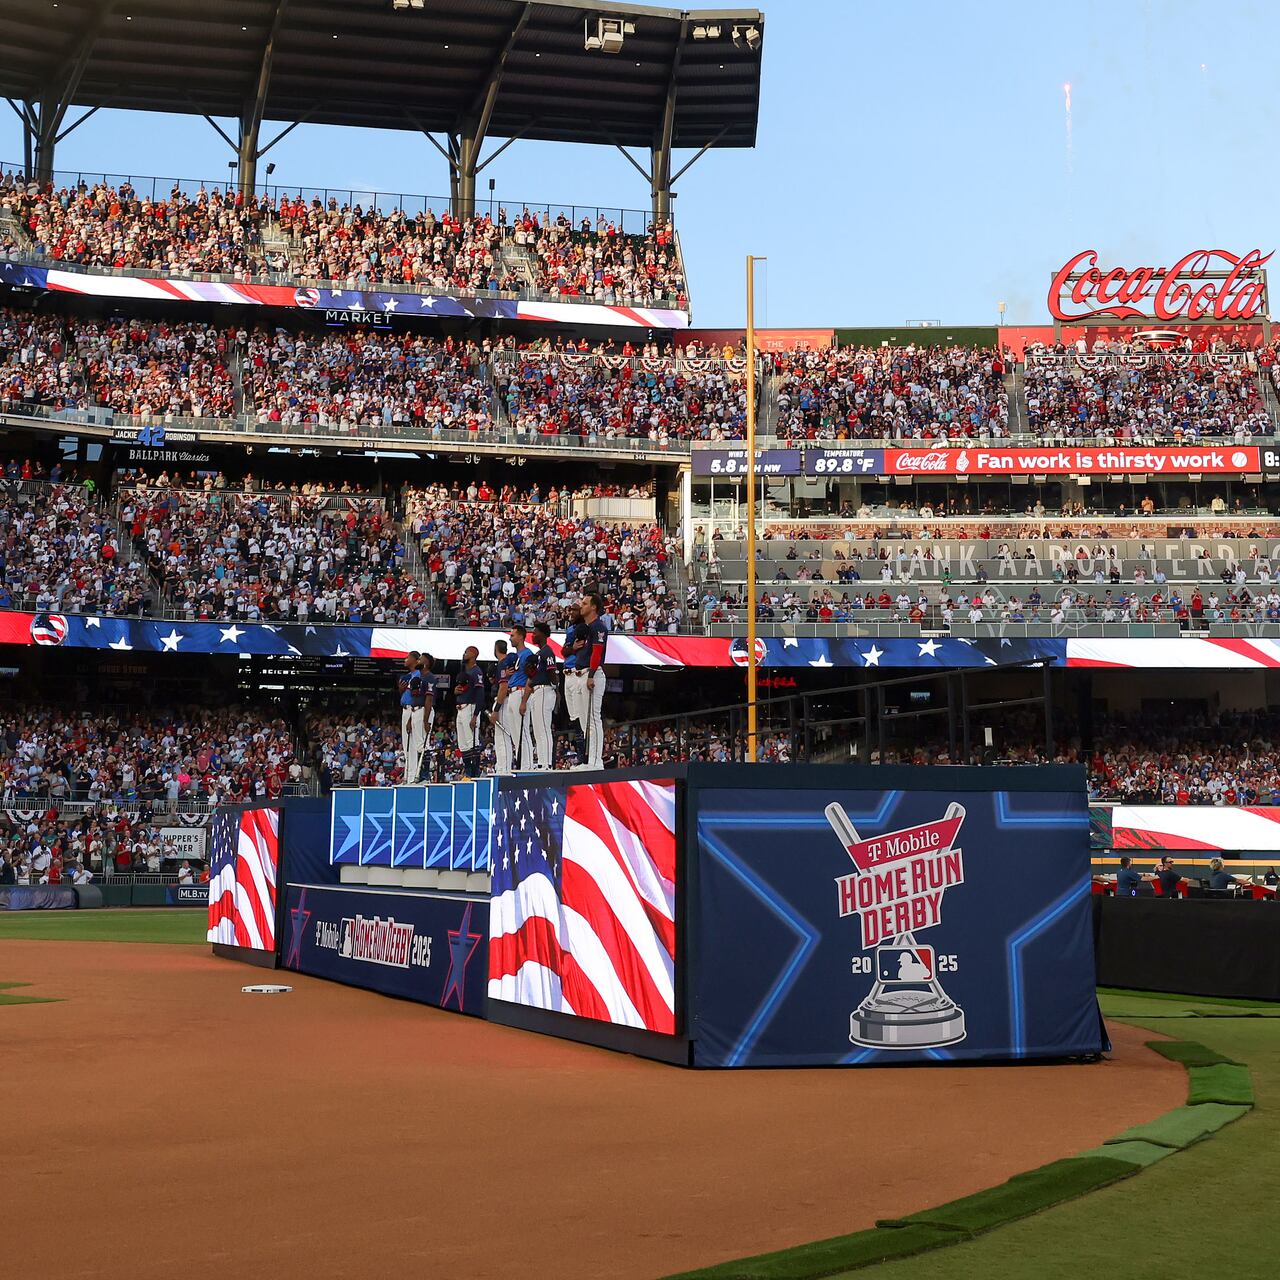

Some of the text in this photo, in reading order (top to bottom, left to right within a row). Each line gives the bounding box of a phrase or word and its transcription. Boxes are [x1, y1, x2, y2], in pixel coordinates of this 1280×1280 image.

[1048, 249, 1276, 321] Coca-Cola
[326, 310, 392, 324] MARKET
[115, 425, 196, 447] JACKIE 42 ROBINSON
[129, 449, 178, 462] BALLPARK
[823, 450, 864, 458] TEMPERATURE
[895, 451, 1224, 472] Coca-Cola Fan work is thirsty work
[710, 459, 781, 473] 5.8 MH NW
[814, 458, 853, 473] 89.8
[885, 545, 977, 576] HANK
[998, 545, 1123, 576] AARON
[163, 834, 199, 843] HIPPER'S
[885, 830, 940, 858] Mobile
[839, 853, 962, 915] HOME RUN
[863, 891, 941, 948] DERBY
[321, 922, 339, 950] Mobile
[385, 923, 414, 966] DERBY
[412, 935, 433, 968] 2025
[851, 955, 959, 974] 20 25
